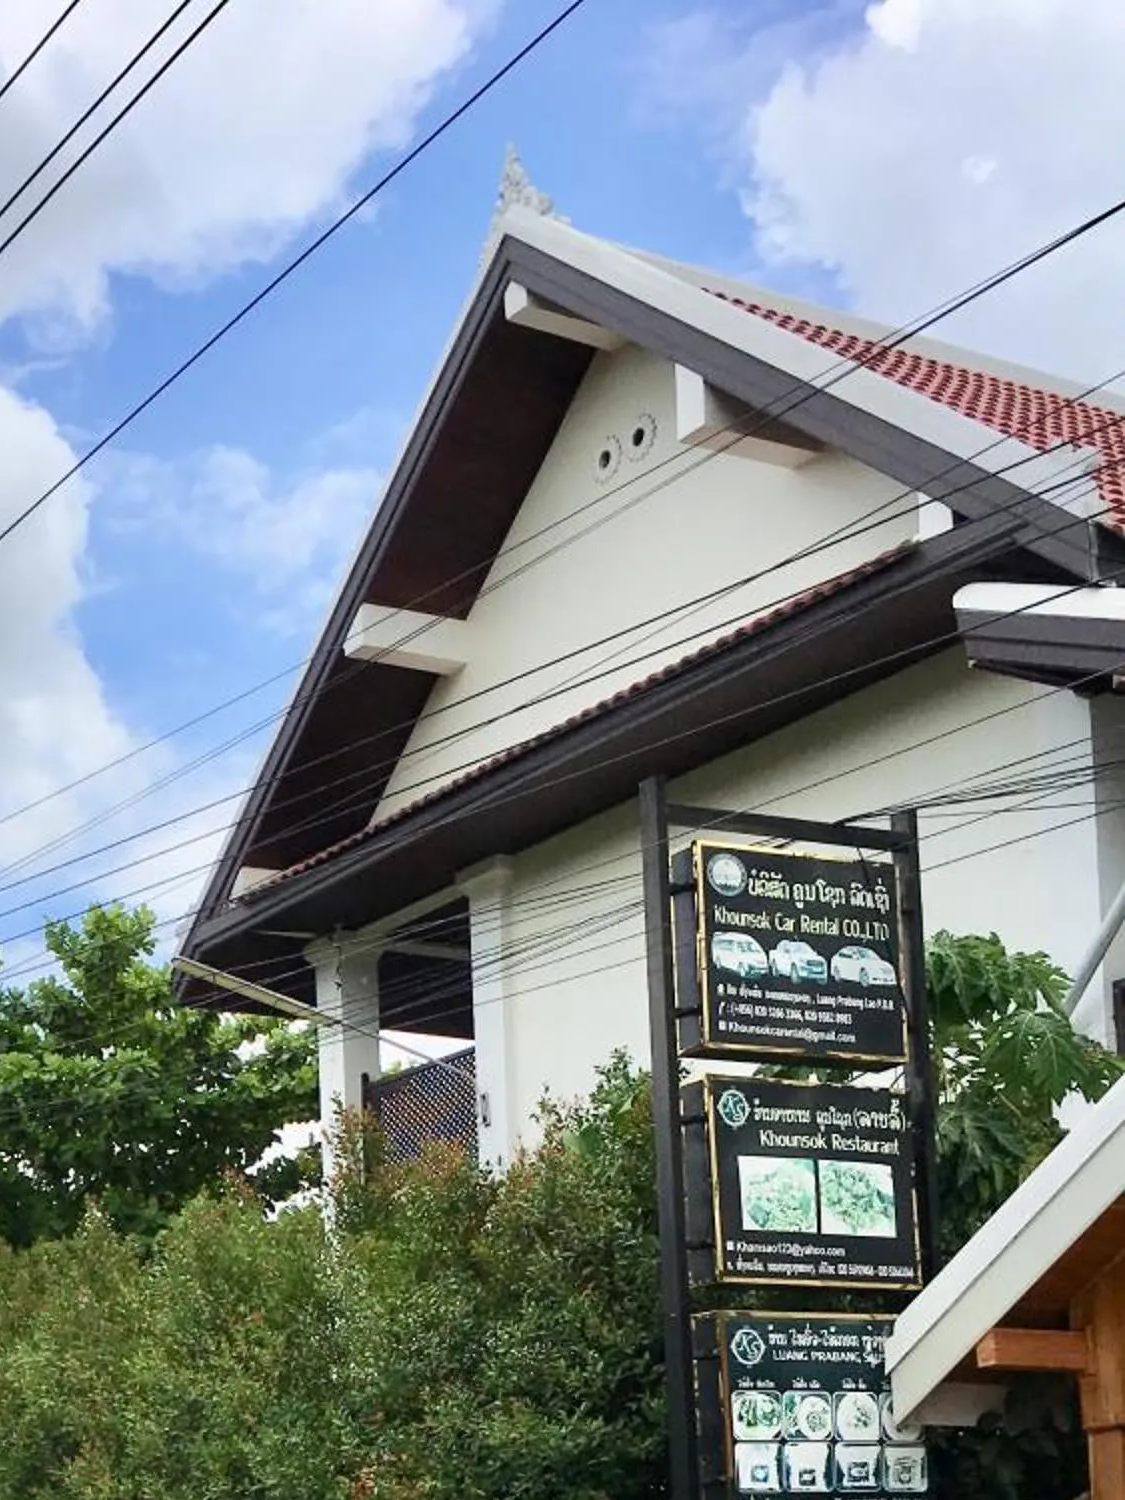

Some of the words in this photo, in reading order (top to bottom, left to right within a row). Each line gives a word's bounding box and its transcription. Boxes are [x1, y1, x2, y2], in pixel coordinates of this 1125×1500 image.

[713, 904, 772, 930] Khounsok
[775, 912, 795, 932] Car
[800, 914, 839, 936] Rental
[759, 1129, 827, 1150] Khounsok
[831, 1133, 900, 1156] Restaurant
